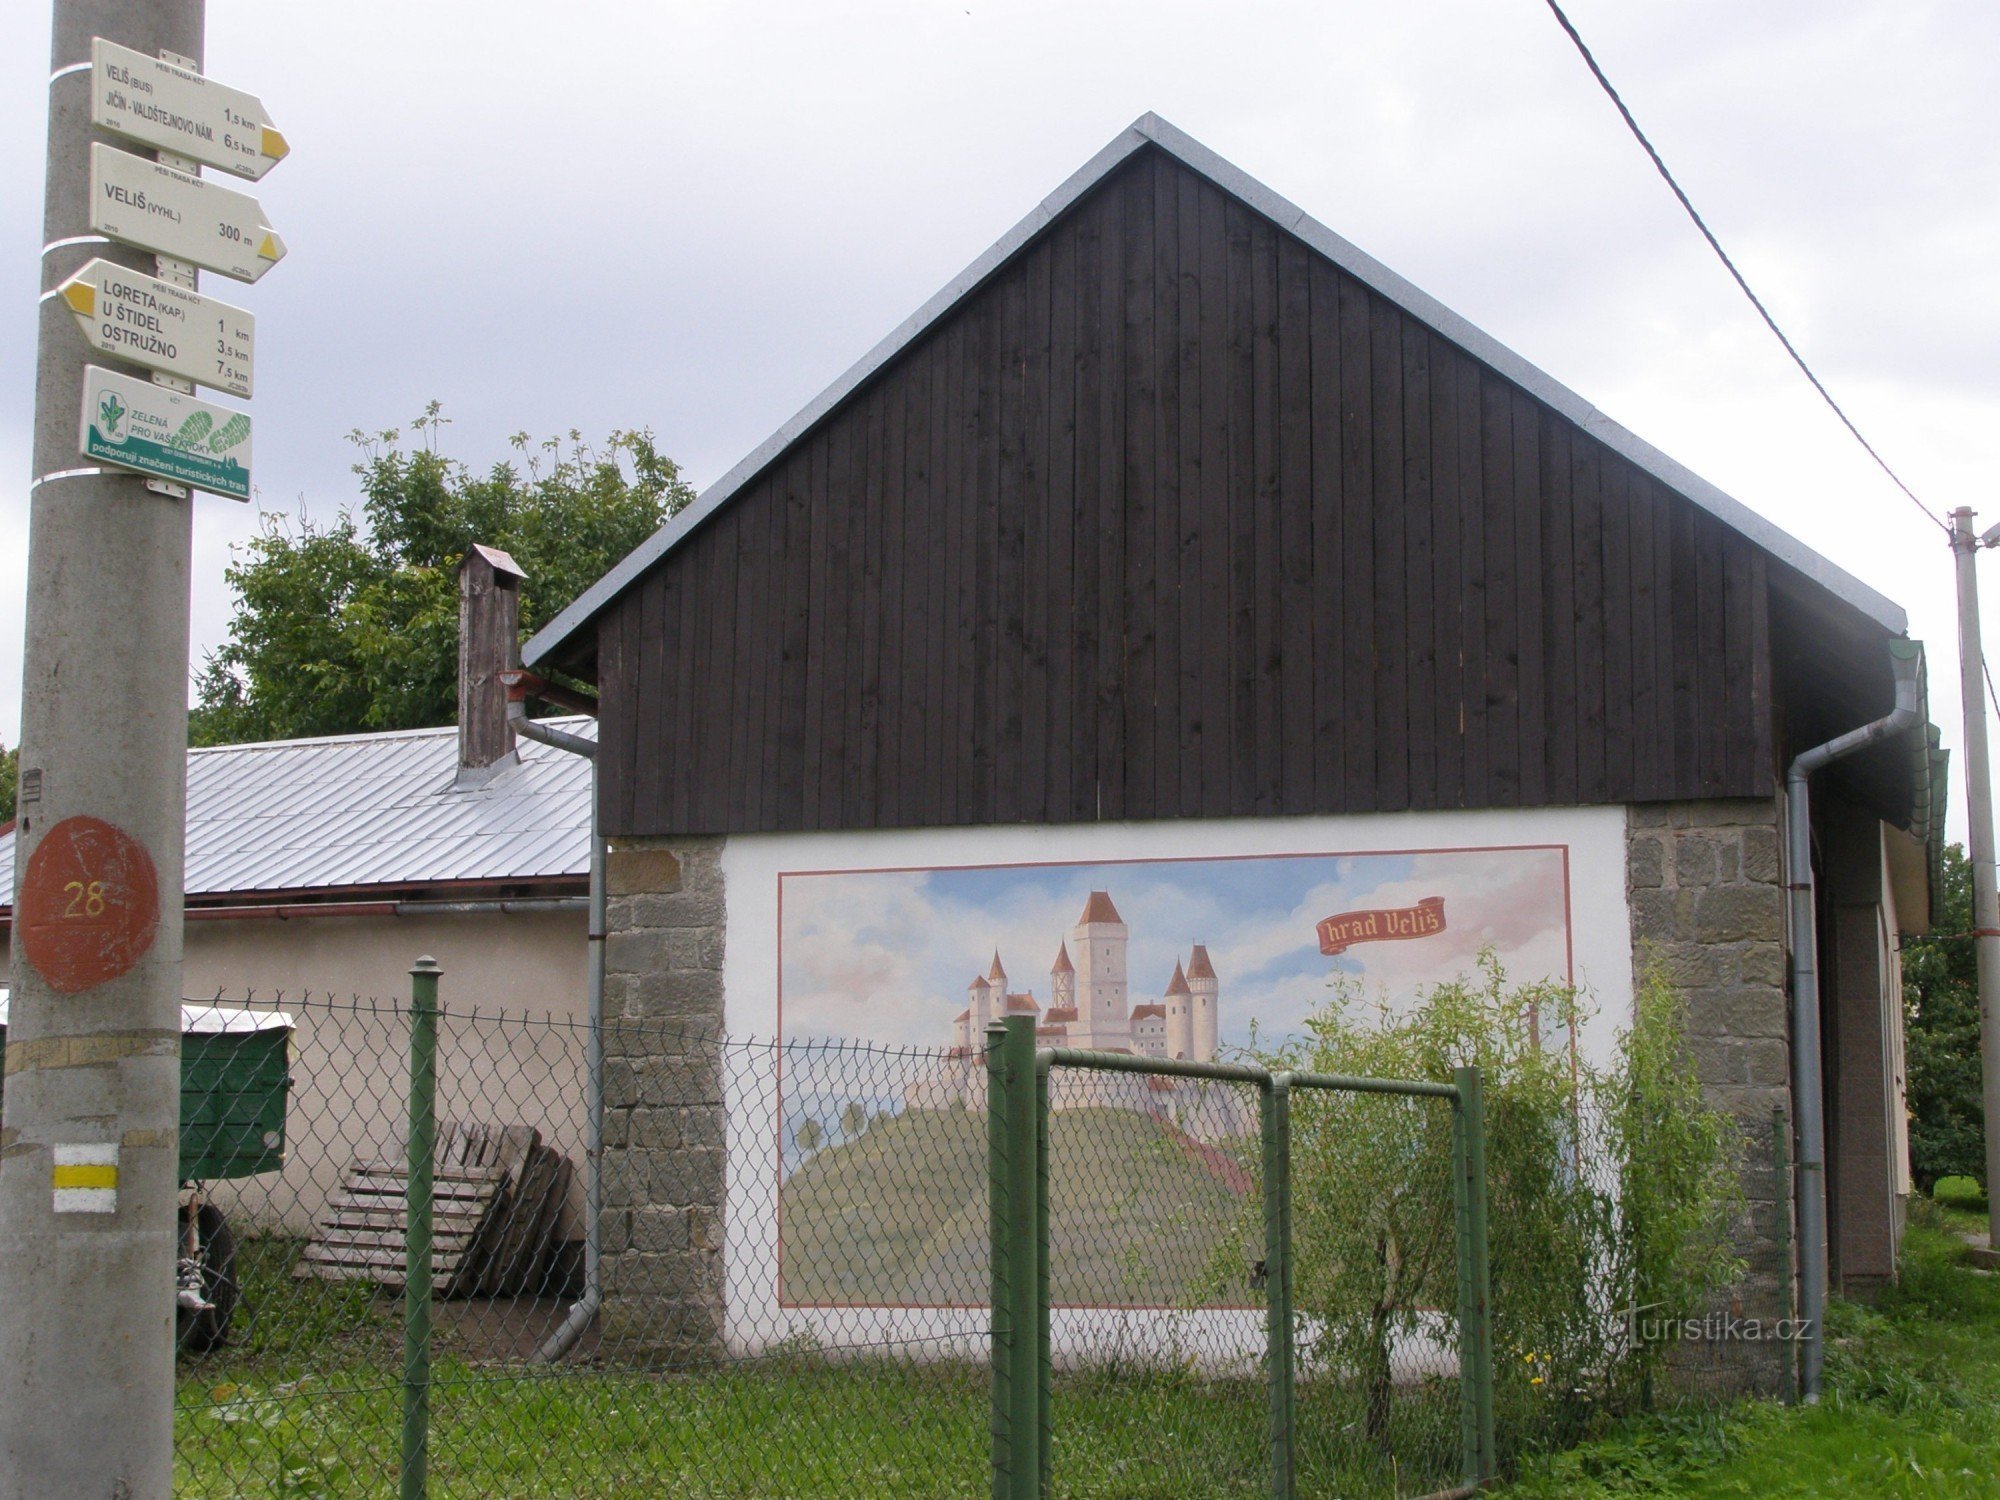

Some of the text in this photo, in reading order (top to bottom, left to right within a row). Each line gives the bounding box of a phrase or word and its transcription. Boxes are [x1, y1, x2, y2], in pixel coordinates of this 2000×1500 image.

[105, 63, 153, 96] VELIŠ (BUS)
[171, 68, 192, 82] TRASA
[105, 90, 127, 112] JIČÍN
[132, 101, 193, 136] VALDŠTEJNOVO
[195, 121, 214, 142] NÁM.
[224, 107, 256, 131] 1,5 km
[223, 133, 256, 157] 6,5 km
[170, 172, 191, 185] TRASA
[104, 182, 182, 225] VELIŠ (VYHL.)
[104, 222, 119, 234] 2010
[218, 222, 253, 247] 300 m
[103, 279, 186, 323] LORETA (KAP.)
[167, 288, 188, 302] TRASA
[103, 301, 164, 335] U ŠTIDEL
[217, 319, 250, 342] 1 km
[102, 323, 177, 360] OSTRUŽNO
[217, 339, 249, 362] 3,5 km
[216, 360, 249, 383] 7,5 km
[131, 409, 169, 429] ZELENÁ
[130, 424, 151, 439] PRO
[179, 438, 211, 455] KROKY
[92, 442, 137, 463] podporují
[138, 452, 174, 473] značení
[175, 462, 227, 486] turistických
[228, 480, 246, 492] tras
[63, 881, 106, 919] 28
[1325, 913, 1378, 942] hrad
